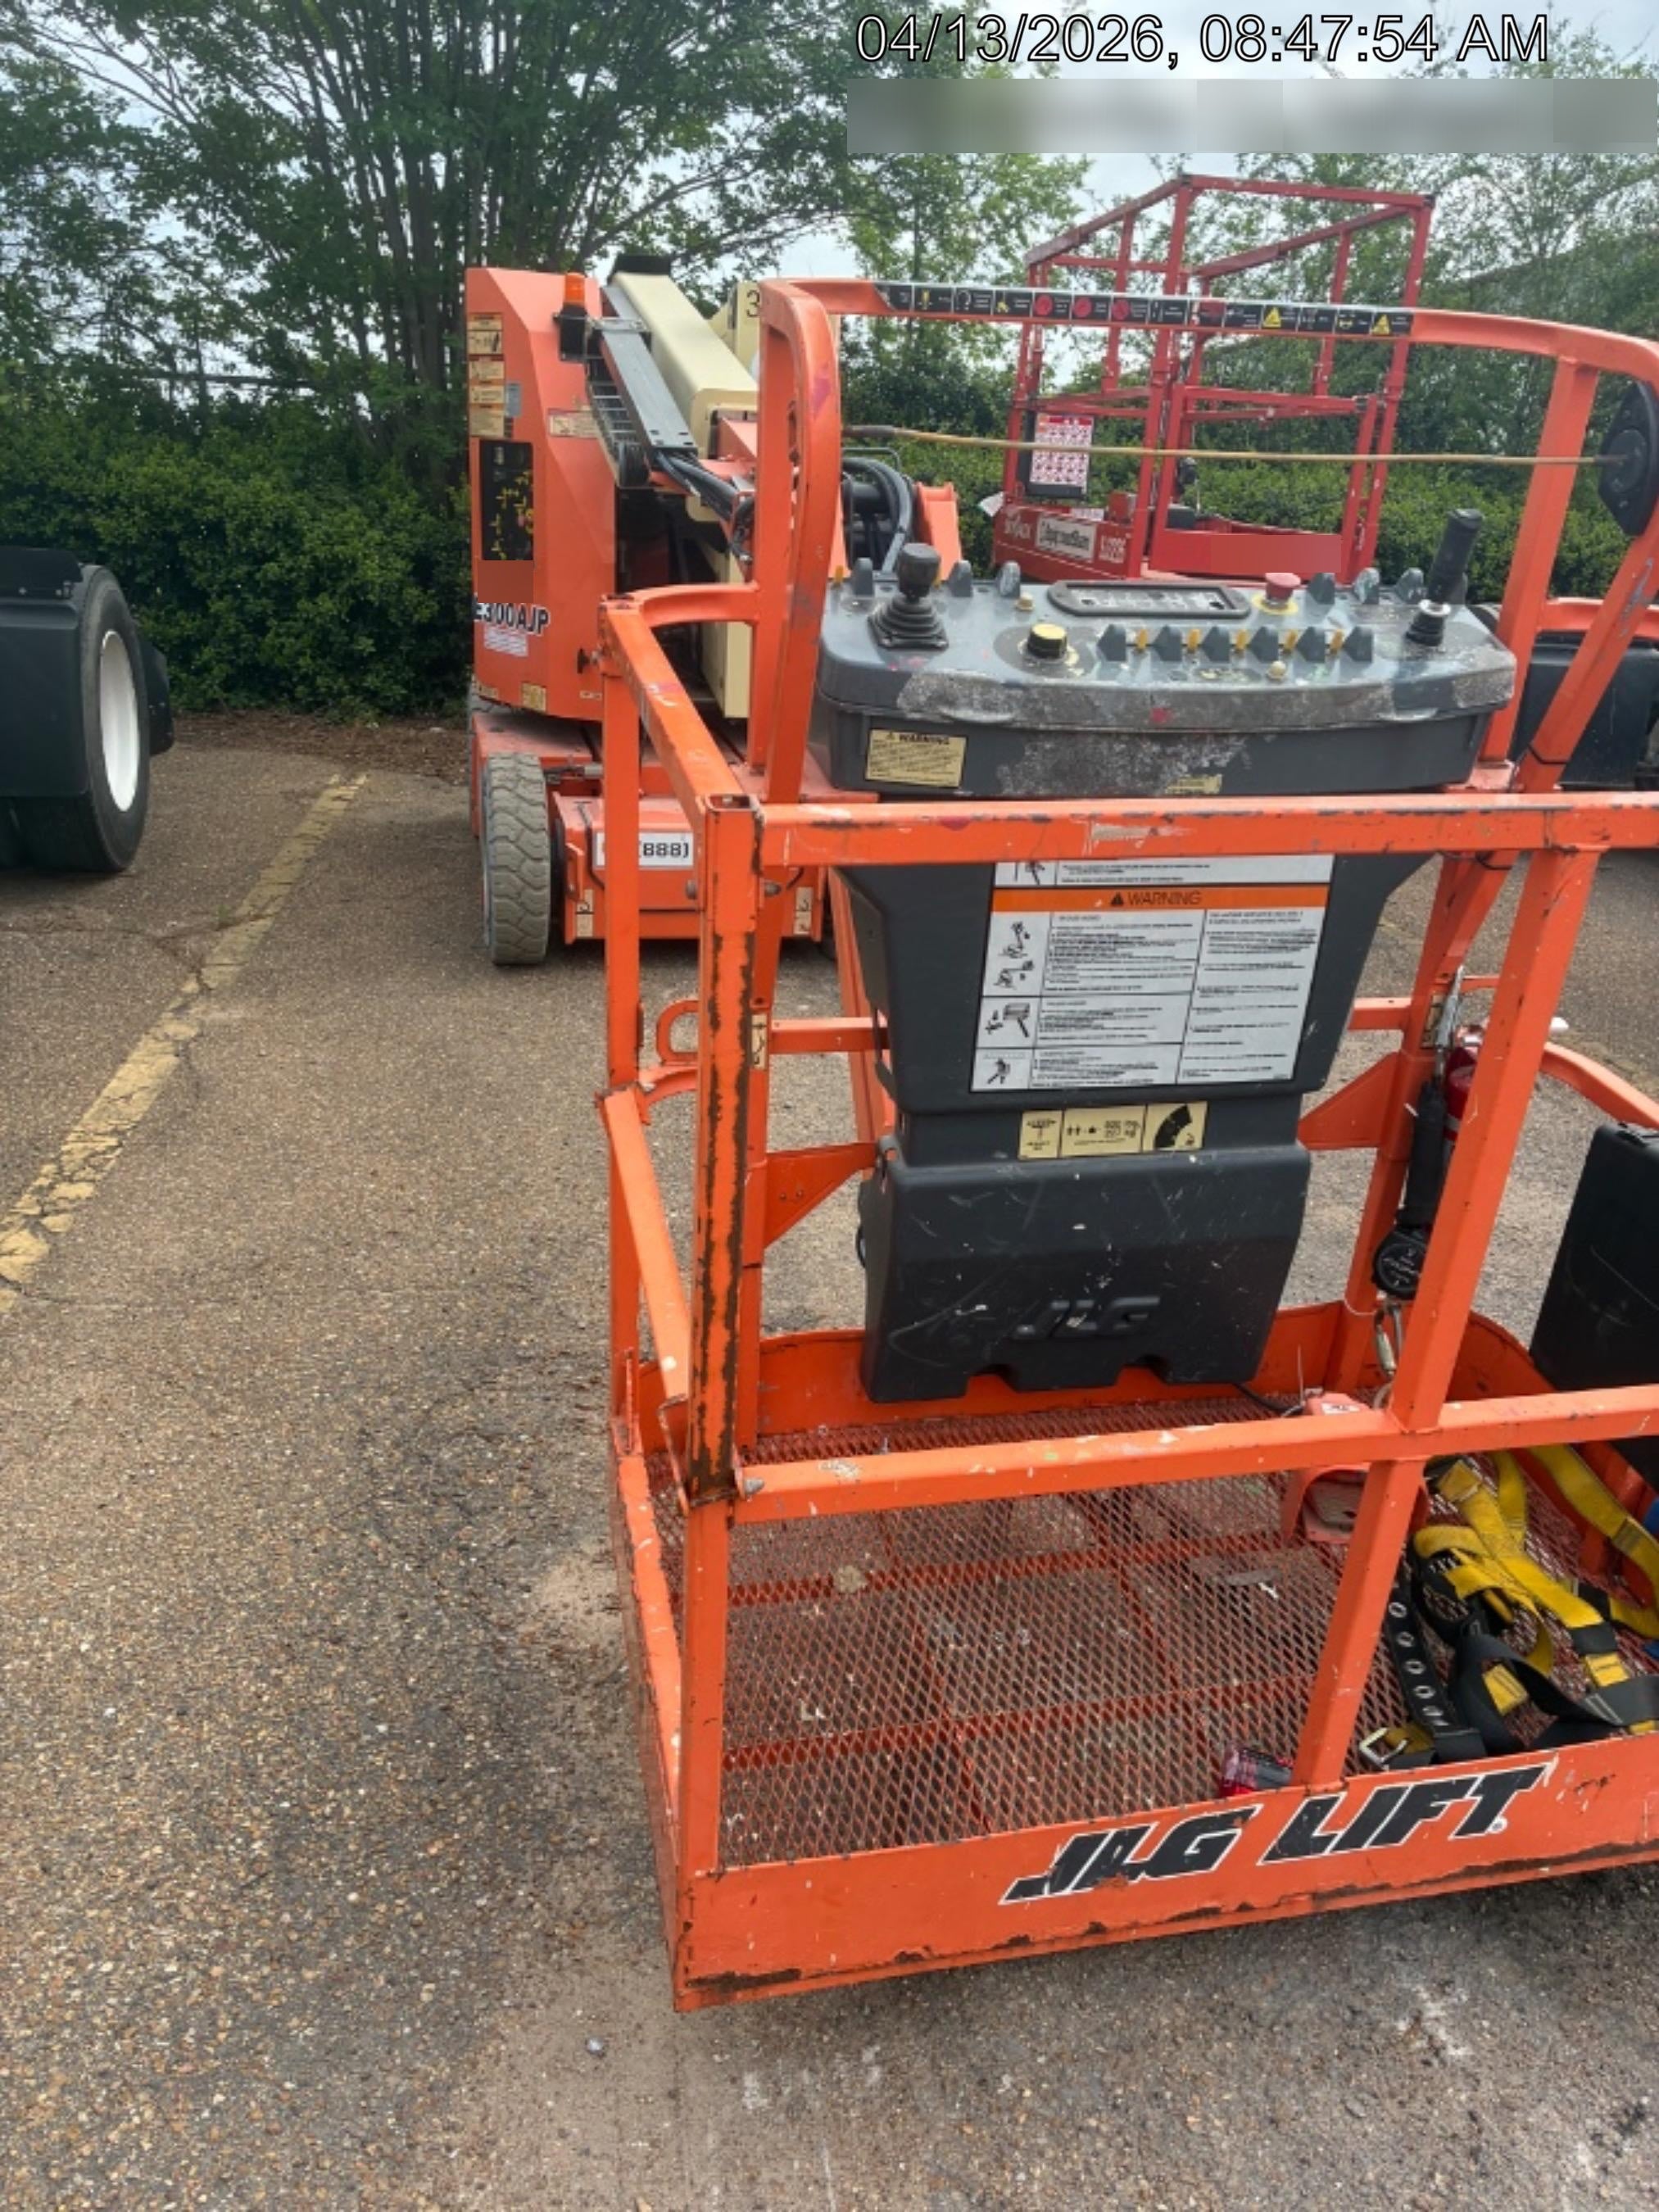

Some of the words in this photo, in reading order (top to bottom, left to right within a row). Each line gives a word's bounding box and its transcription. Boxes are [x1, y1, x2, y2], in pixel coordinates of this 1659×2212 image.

[1128, 891, 1201, 905] WARNING
[998, 1804, 1264, 1905] JLG
[1257, 1763, 1556, 1865] LIFT
